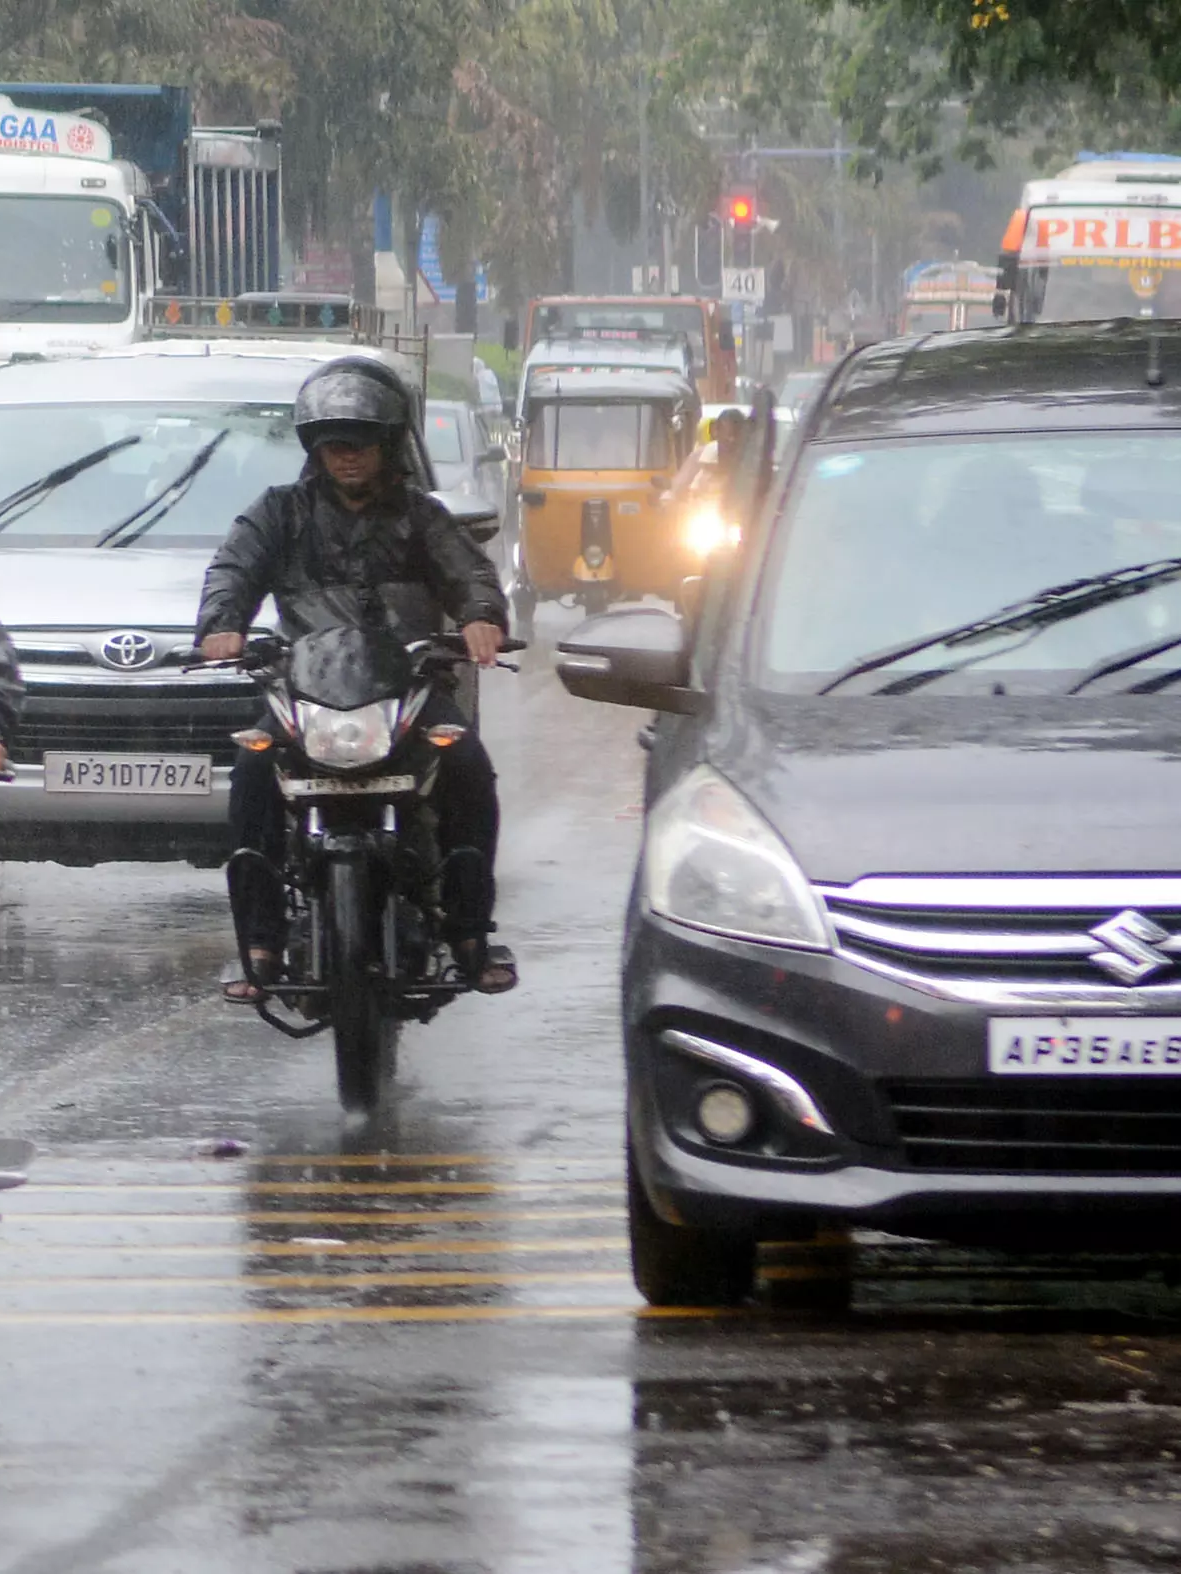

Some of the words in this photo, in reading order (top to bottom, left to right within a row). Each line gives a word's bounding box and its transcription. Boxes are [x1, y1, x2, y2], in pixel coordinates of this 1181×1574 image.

[1035, 218, 1181, 249] PRLB
[730, 274, 756, 293] 40
[62, 761, 207, 788] AP31DT7874
